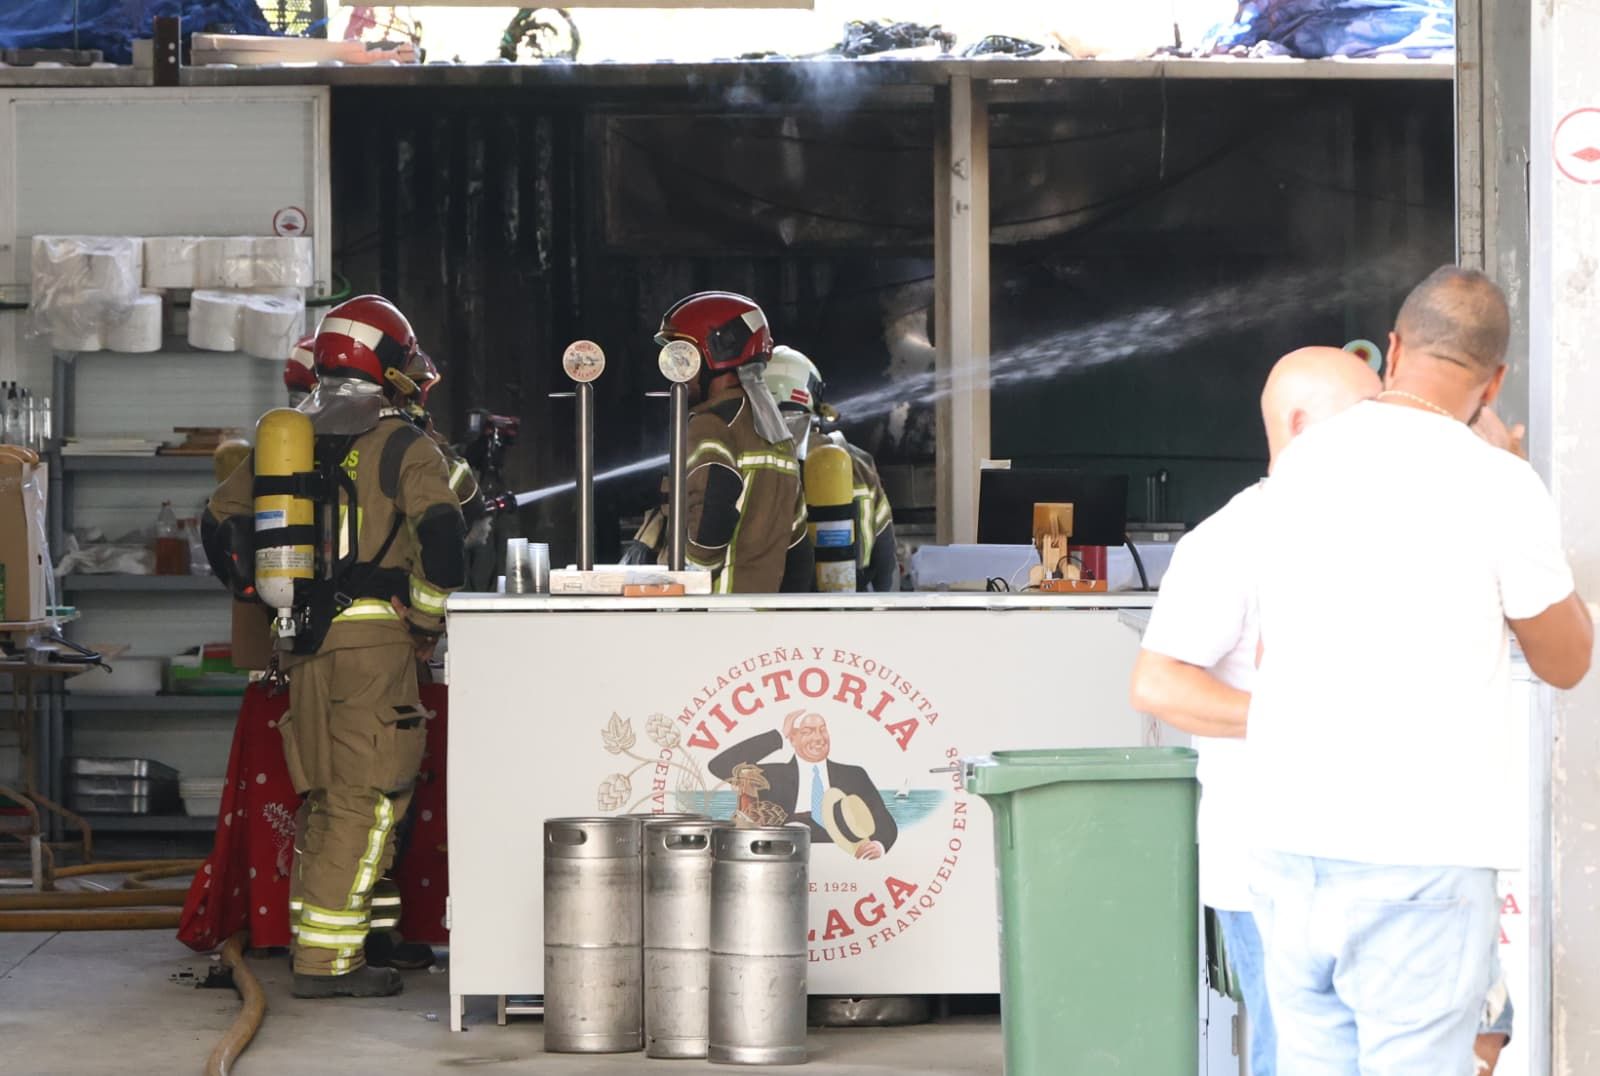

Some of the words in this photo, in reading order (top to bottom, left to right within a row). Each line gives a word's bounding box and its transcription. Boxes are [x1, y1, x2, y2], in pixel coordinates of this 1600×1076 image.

[678, 646, 805, 726] MALAGUEÑA
[812, 647, 824, 660] Y
[832, 648, 941, 727] EXQUISITA
[686, 666, 921, 753] VICTORIA
[808, 941, 862, 962] LUIS
[866, 837, 963, 950] FRANQUELO
[952, 801, 968, 832] EN
[823, 882, 858, 893] 1928
